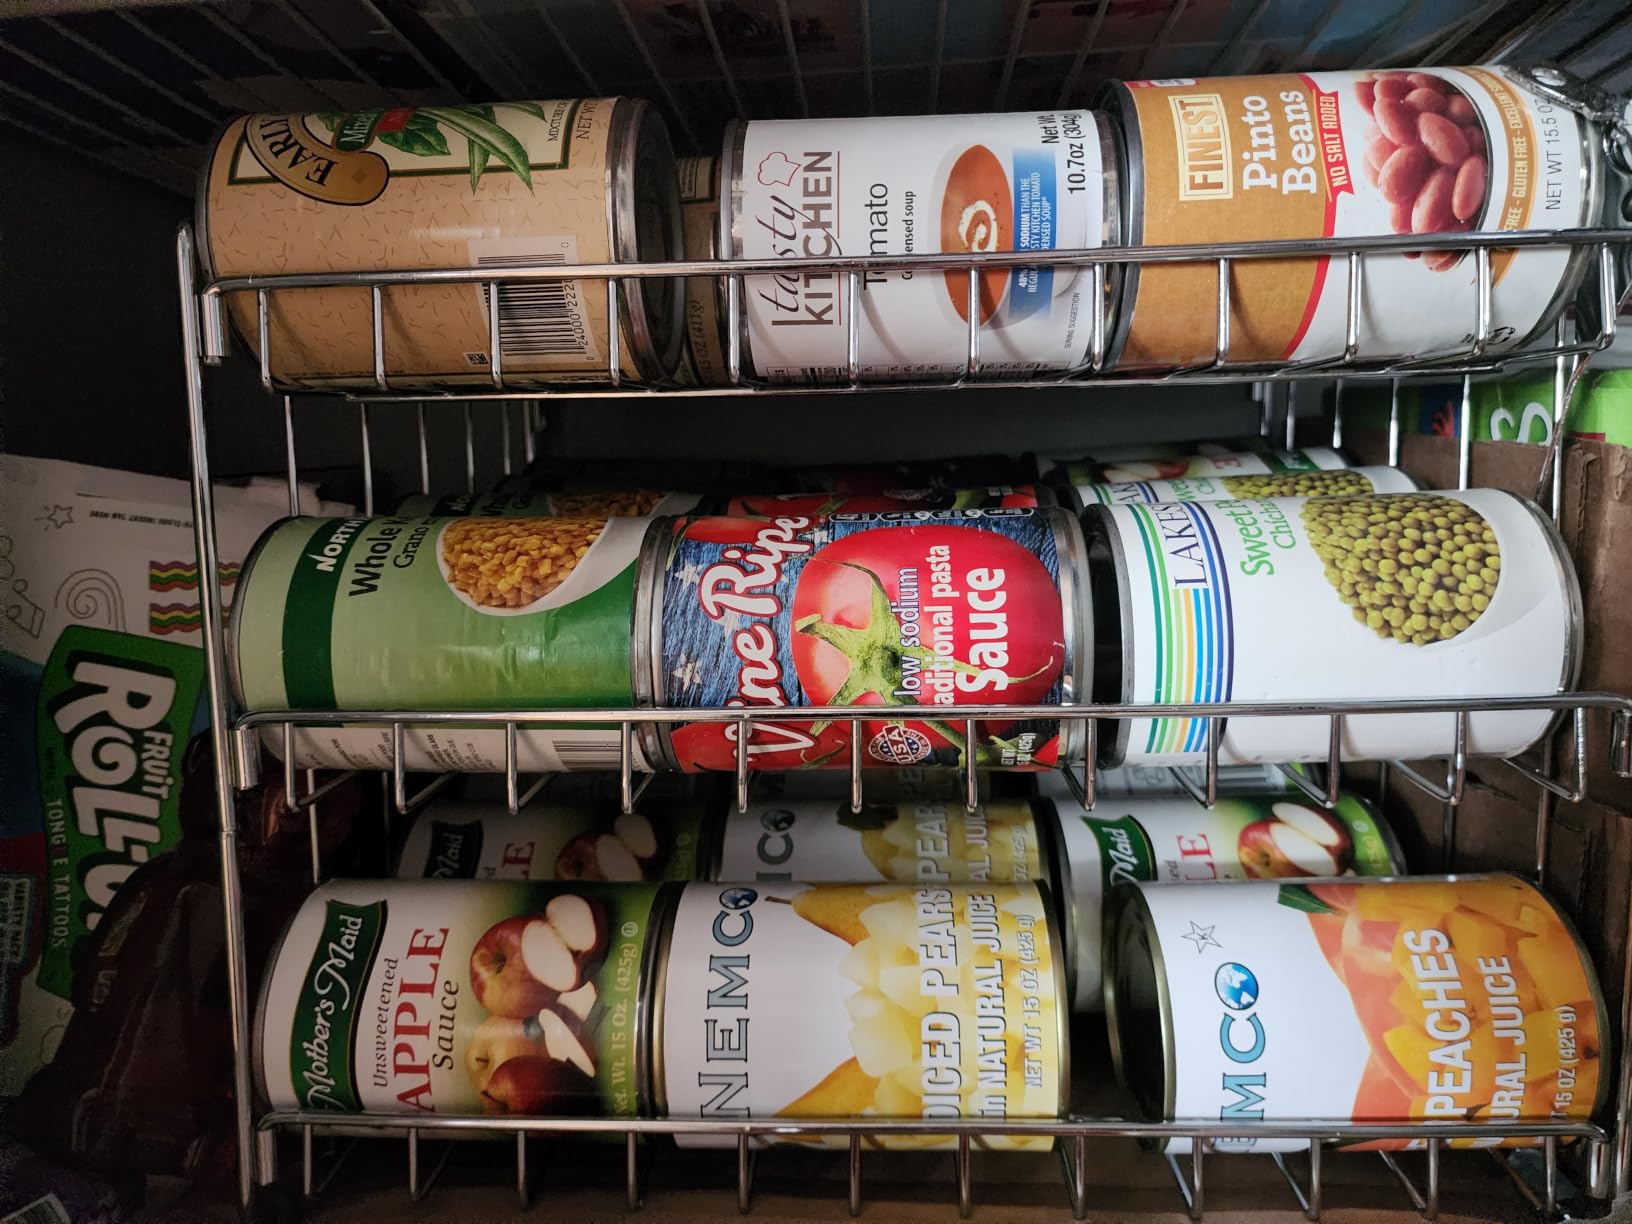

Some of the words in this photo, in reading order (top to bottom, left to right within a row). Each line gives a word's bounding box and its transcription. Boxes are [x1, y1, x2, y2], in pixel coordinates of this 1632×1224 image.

[575, 116, 593, 140] NET
[1318, 95, 1338, 130] ADDED
[1498, 91, 1523, 130] EXCELLENT
[1540, 117, 1561, 146] 15.5
[1040, 125, 1060, 144] Net
[1179, 98, 1225, 192] FINEST
[1241, 95, 1278, 190] Pinto
[1279, 90, 1318, 195] Beans
[1323, 133, 1342, 162] SALT
[1512, 136, 1527, 159] FREE
[1020, 176, 1031, 191] THE
[1066, 153, 1087, 196] 10.7oz
[1330, 163, 1348, 187] NO
[1511, 160, 1528, 198] GLUTEN
[1546, 150, 1562, 176] WT
[904, 190, 917, 216] soup
[1020, 191, 1031, 213] THAN
[1030, 171, 1041, 200] TOMATO
[1545, 178, 1562, 210] NET
[863, 183, 888, 291] Tmato
[1020, 213, 1032, 248] SODIUM
[1031, 201, 1042, 233] KITCHEN
[755, 195, 842, 313] tasty
[772, 151, 834, 326] KITCHEN
[1068, 292, 1081, 329] SUGGESTION
[348, 527, 404, 597] Whole
[393, 525, 430, 569] Grano
[1226, 510, 1275, 576] Sweet
[699, 515, 813, 620] Ripe
[926, 545, 961, 599] pasta
[890, 568, 921, 648] sodium
[955, 567, 1009, 694] Sauce
[893, 655, 922, 697] low
[924, 606, 956, 706] aditional
[887, 727, 912, 763] USA
[914, 805, 950, 880] PEAR
[911, 888, 960, 997] PEARS
[966, 893, 1003, 953] JUICE
[314, 914, 363, 1011] Maid
[614, 943, 638, 993] (425g)
[1018, 968, 1038, 992] OZ
[373, 958, 399, 1088] Unsweetened
[392, 927, 451, 1114] APPLE
[973, 957, 1008, 1089] NATURAL
[1021, 997, 1041, 1019] 15
[1403, 928, 1474, 1116] PEACHES
[1476, 956, 1527, 1048] JUICE
[431, 980, 460, 1072] Sauce
[611, 1030, 628, 1050] 15
[1022, 1024, 1042, 1054] WT
[303, 999, 346, 1110] Mother's
[1022, 1057, 1043, 1089] NET
[1558, 1068, 1576, 1089] OZ
[976, 1095, 1007, 1118] in
[1555, 1093, 1574, 1109] 15
